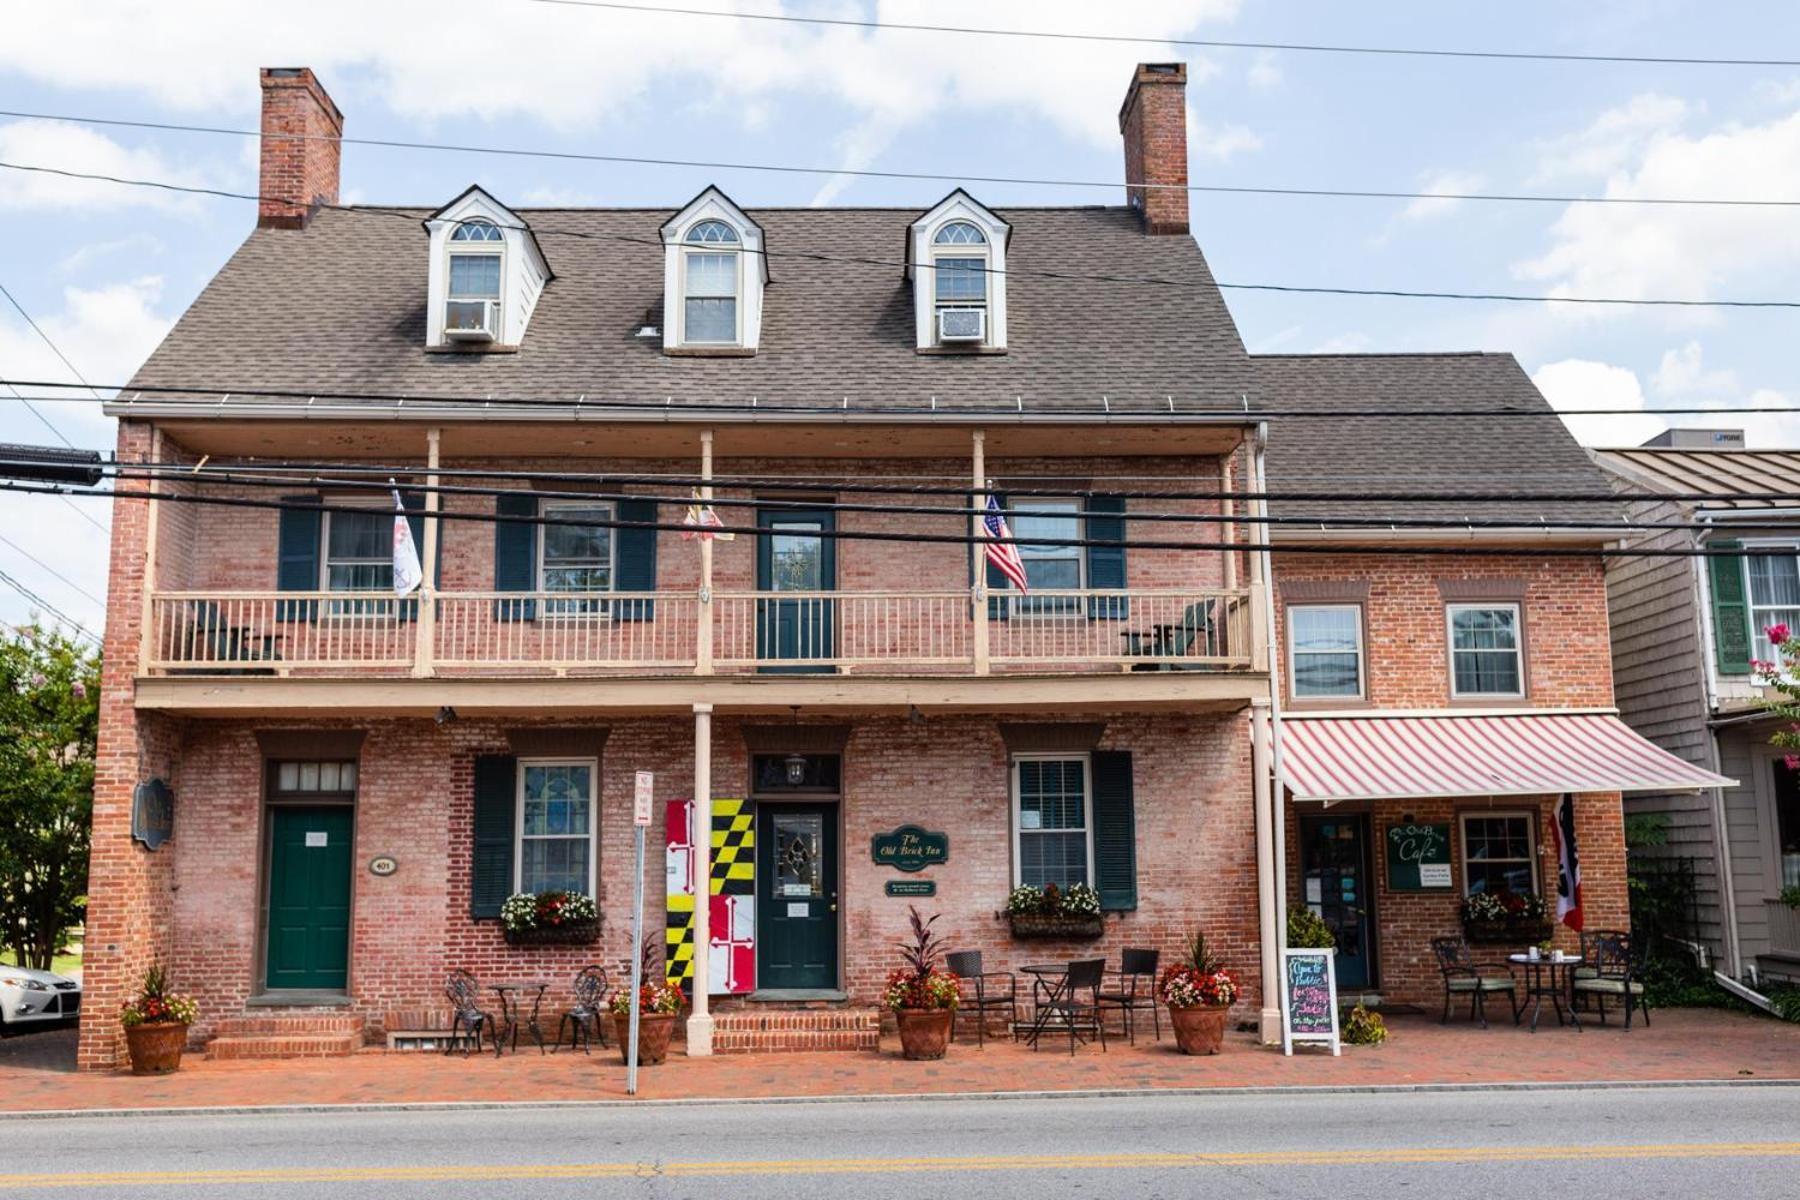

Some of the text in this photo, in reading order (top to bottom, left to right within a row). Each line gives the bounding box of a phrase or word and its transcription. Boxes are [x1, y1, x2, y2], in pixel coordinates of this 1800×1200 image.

[903, 834, 919, 846] The
[880, 845, 941, 857] Old Brick Inn
